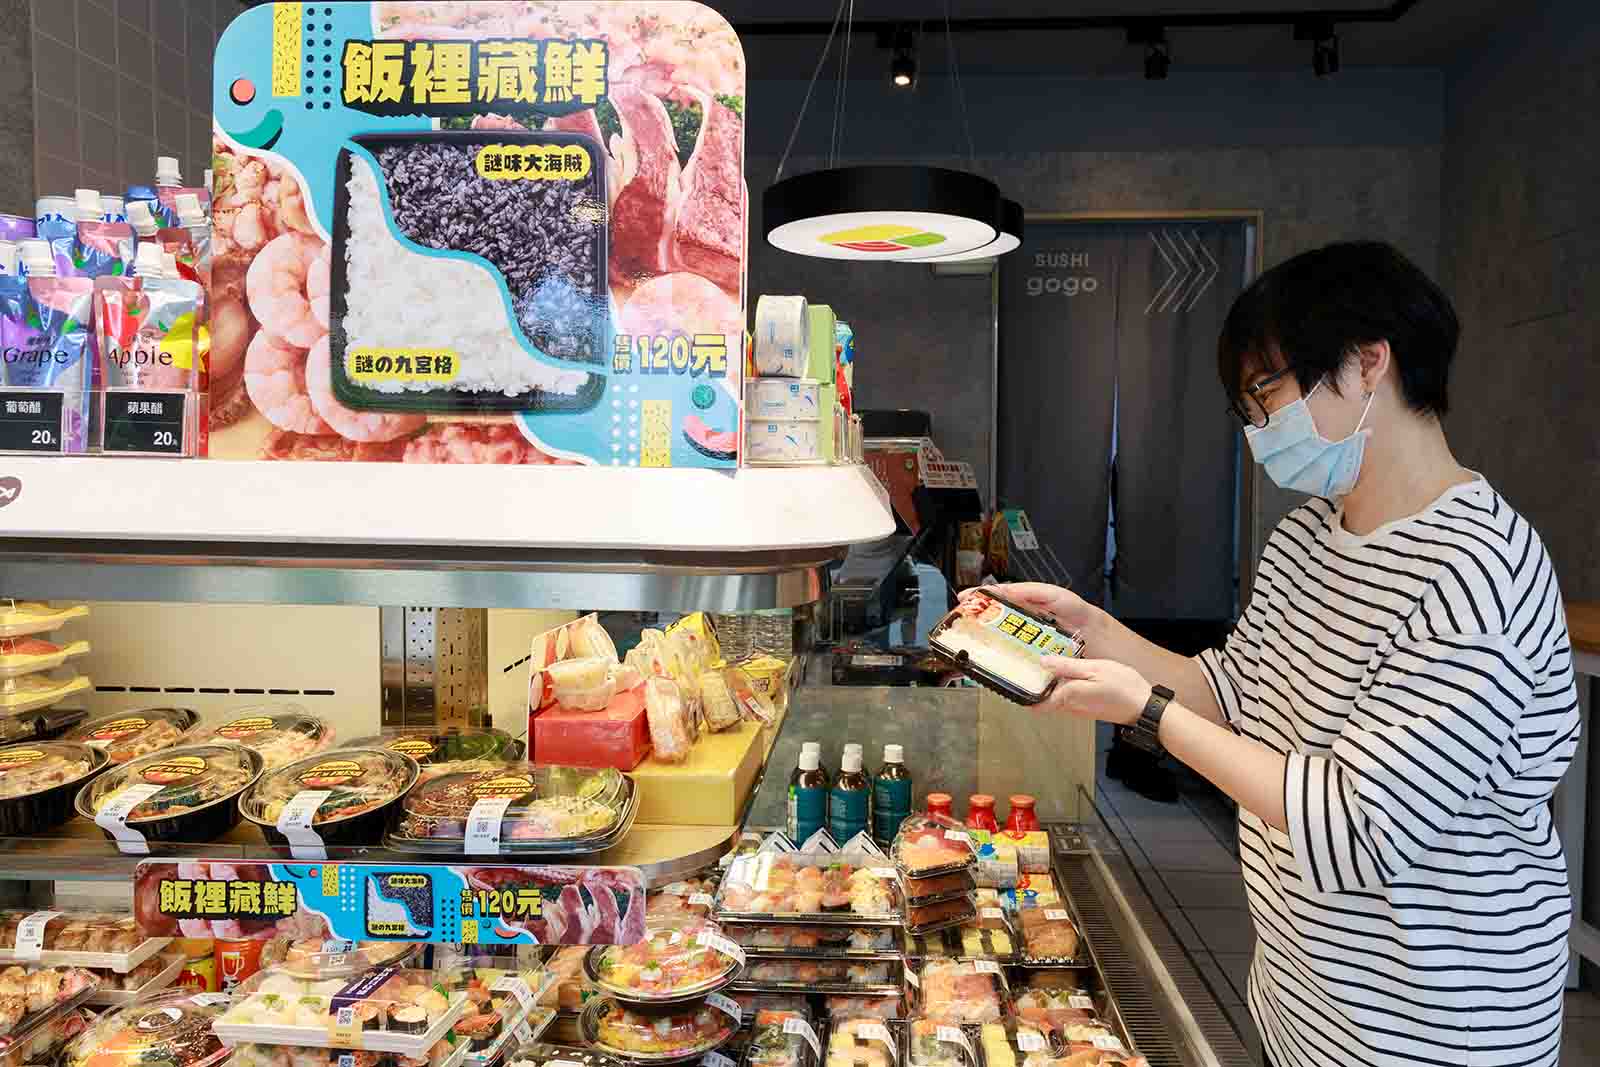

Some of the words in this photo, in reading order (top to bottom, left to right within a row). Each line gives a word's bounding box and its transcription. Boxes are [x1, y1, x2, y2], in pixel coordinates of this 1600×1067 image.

[342, 40, 608, 105] 飯裡藏鮮
[483, 153, 583, 173] 謎味大海賊
[1034, 252, 1089, 267] SUSHI
[1026, 277, 1098, 296] gogo
[3, 347, 69, 367] Grape
[355, 355, 453, 374] 謎の九宮格
[638, 334, 727, 375] 120元
[5, 400, 41, 414] 葡萄醋
[127, 401, 164, 415] 蘋果醋
[160, 880, 298, 916] 飯裡藏鮮
[478, 889, 543, 918] 120元
